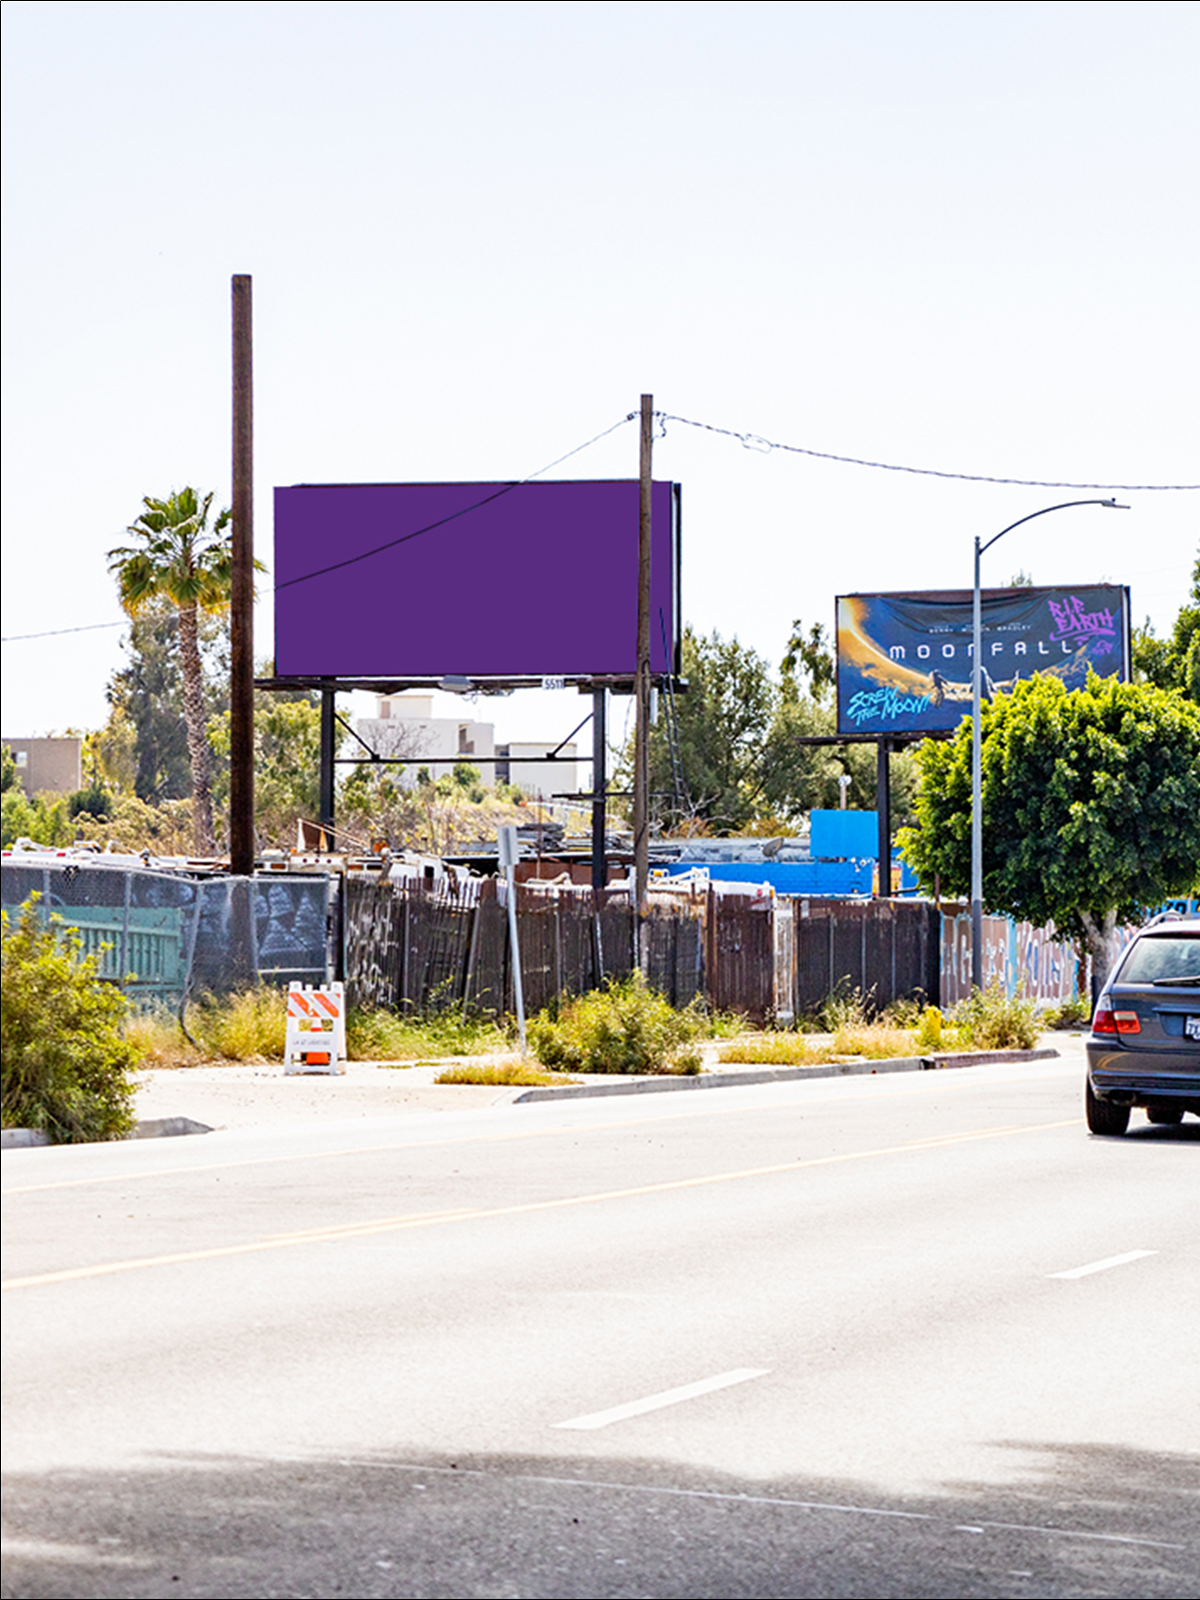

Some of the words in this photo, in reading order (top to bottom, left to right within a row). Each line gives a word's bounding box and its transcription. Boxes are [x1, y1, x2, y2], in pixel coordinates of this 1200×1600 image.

[1054, 607, 1114, 634] EARTH
[846, 685, 900, 716] SCREW
[850, 705, 881, 727] THE
